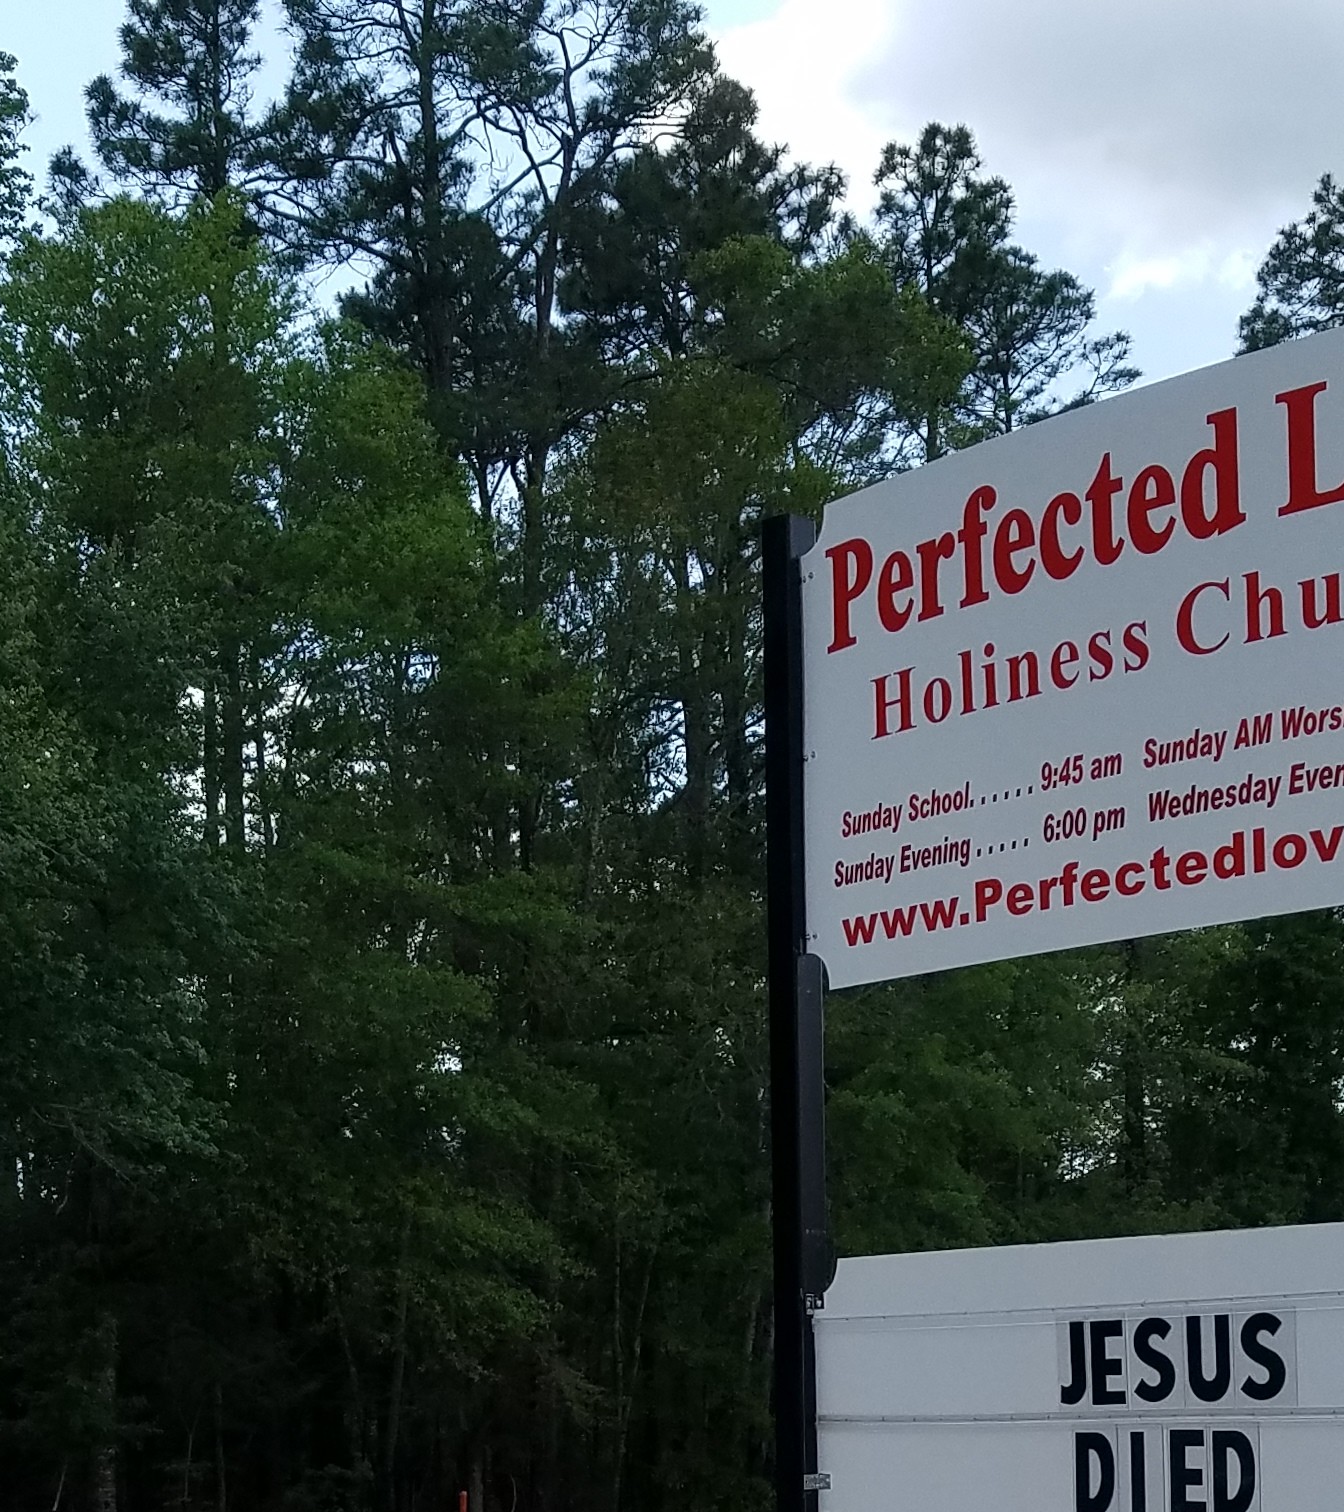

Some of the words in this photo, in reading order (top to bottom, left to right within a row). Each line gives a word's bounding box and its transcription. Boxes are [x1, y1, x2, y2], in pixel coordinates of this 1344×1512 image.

[824, 406, 1247, 655] Perfected
[870, 620, 1150, 741] Holiness
[1143, 728, 1228, 769] Sunday
[1233, 712, 1273, 751] AM
[841, 802, 903, 839] Sunday
[1040, 754, 1084, 792] 9:45
[1090, 751, 1123, 780] am
[1148, 773, 1282, 822] Wednesday
[834, 852, 895, 888] Sunday
[1043, 807, 1087, 843] 6:00
[1092, 806, 1126, 842] pm
[1059, 1311, 1287, 1406] JESUS
